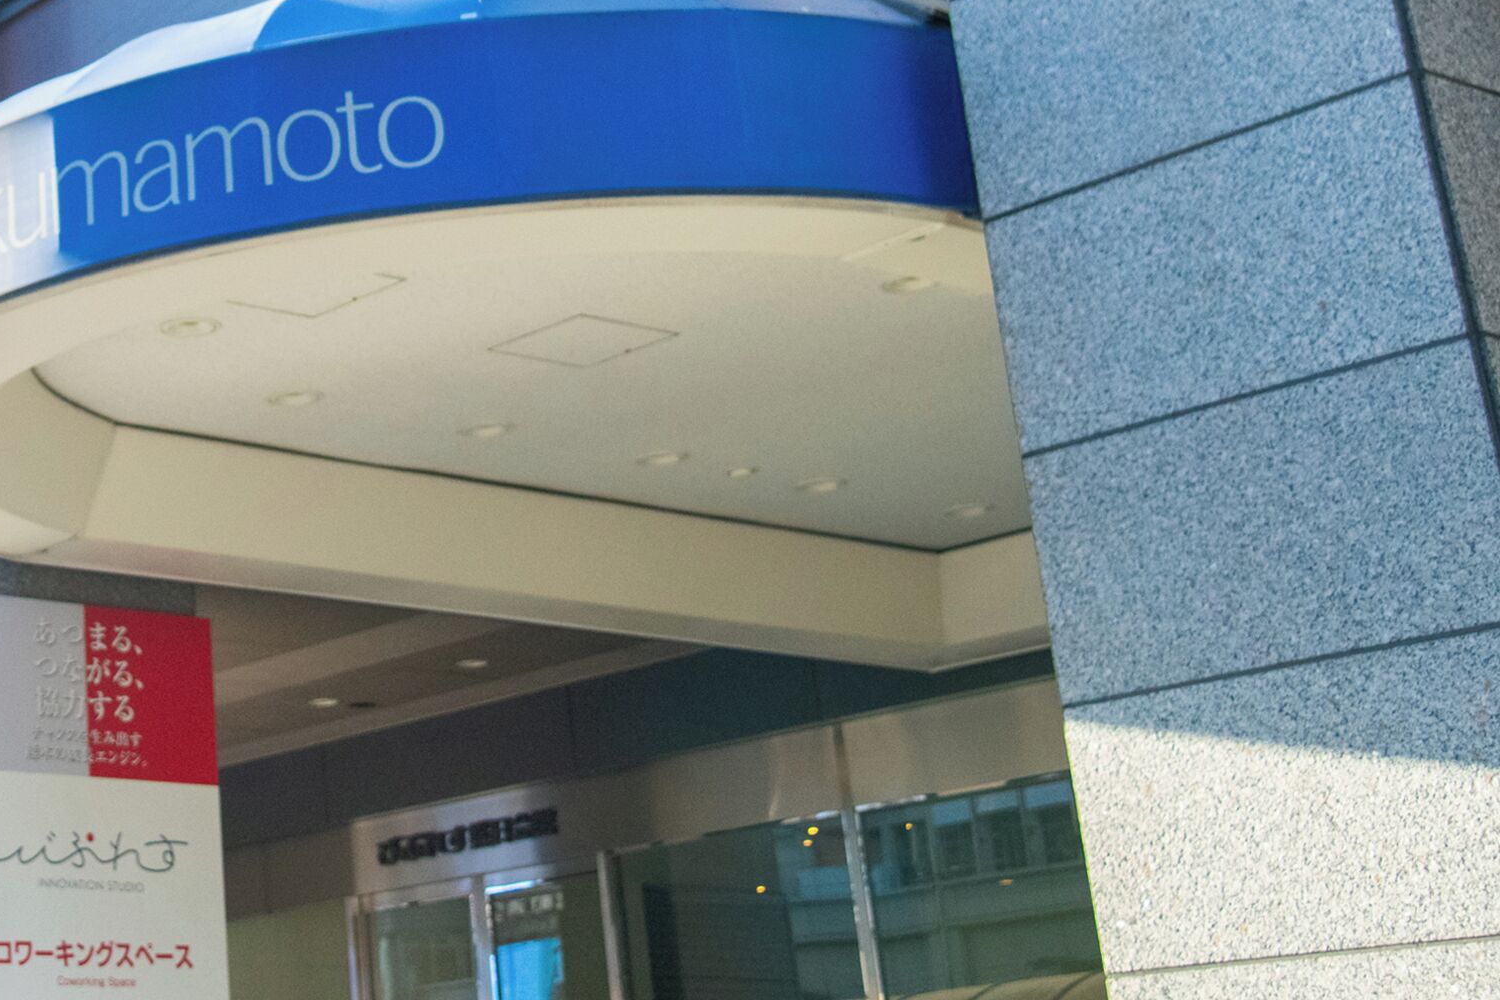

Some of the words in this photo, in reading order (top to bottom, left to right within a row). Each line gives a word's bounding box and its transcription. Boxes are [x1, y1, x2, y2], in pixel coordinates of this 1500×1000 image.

[34, 655, 145, 690] つながる、
[38, 877, 105, 891] INNOVATION
[107, 880, 146, 893] STUDIO
